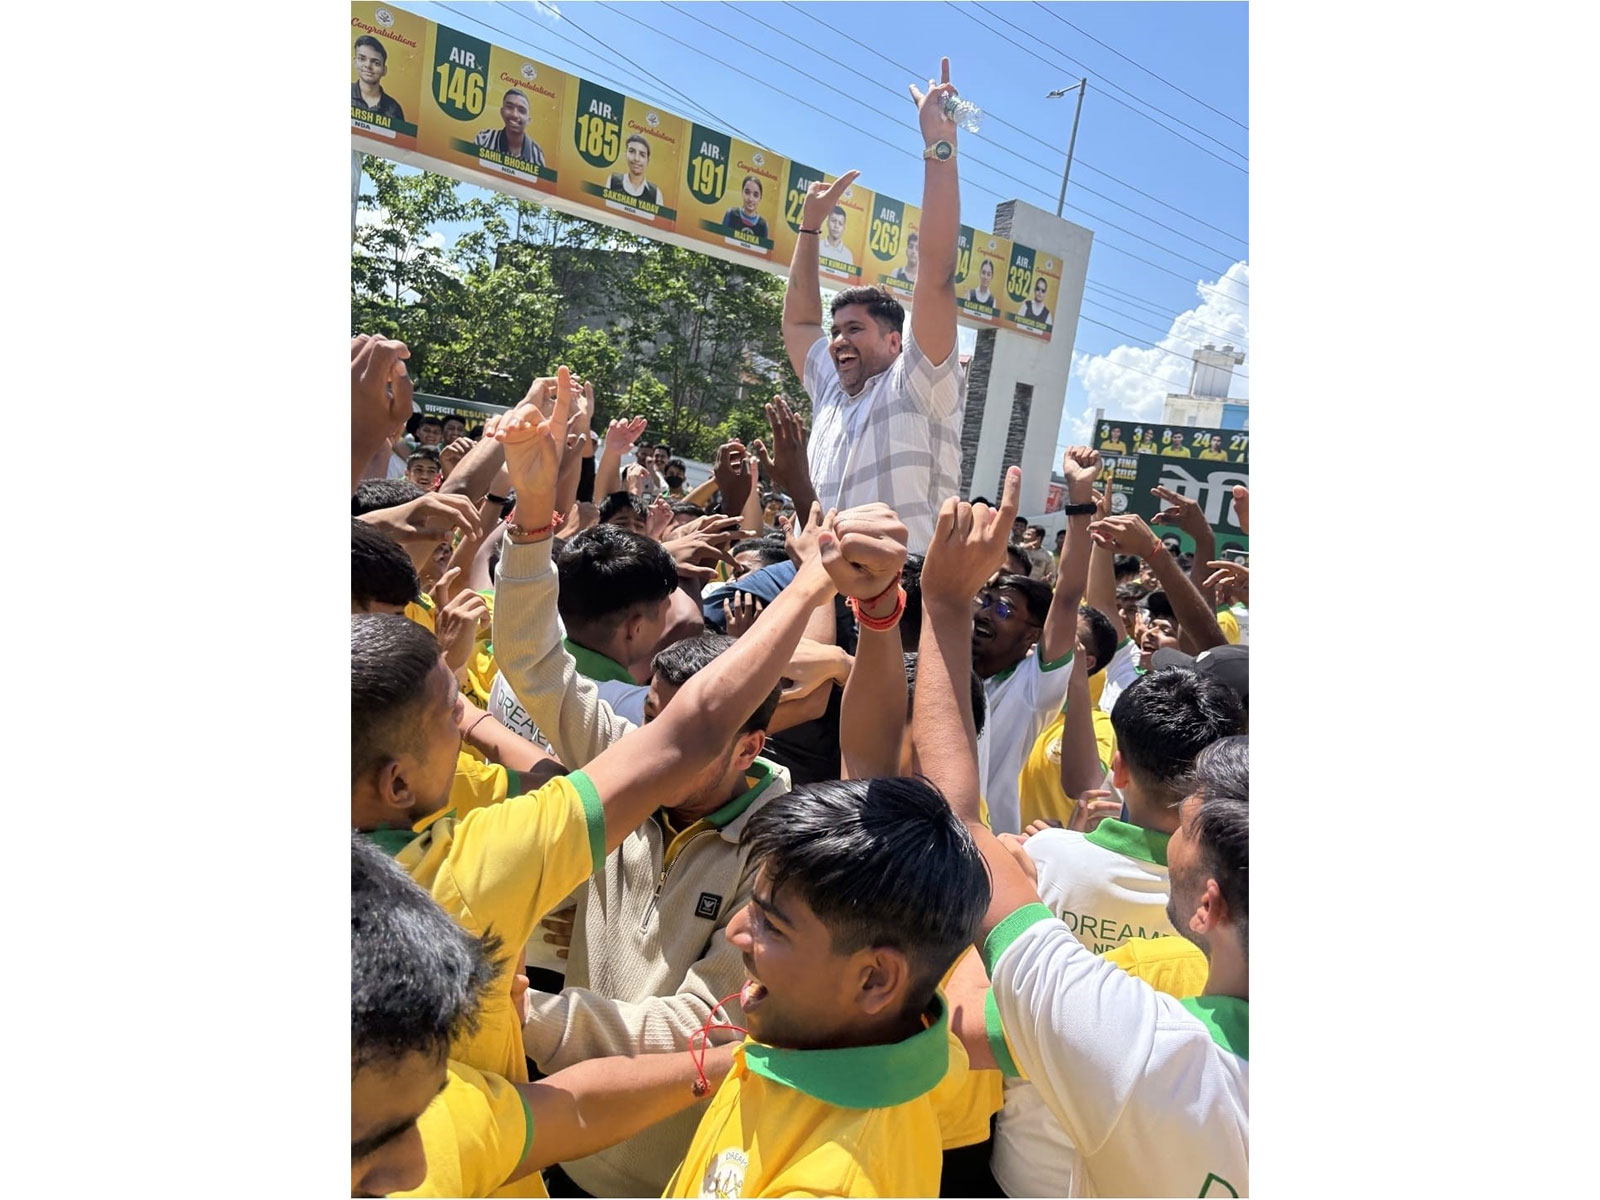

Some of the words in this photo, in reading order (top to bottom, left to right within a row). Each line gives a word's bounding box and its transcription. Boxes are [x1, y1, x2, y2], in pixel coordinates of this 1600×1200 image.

[351, 17, 417, 49] Congratulations
[449, 46, 475, 68] AIR
[437, 63, 485, 115] 146
[500, 72, 556, 99] Congratulations
[351, 107, 374, 122] ARSH
[375, 114, 391, 128] RAI
[589, 99, 612, 119] AIR
[354, 120, 371, 130] NDA
[578, 114, 619, 162] 185
[700, 141, 720, 160] AIR
[479, 148, 502, 164] SAHIL
[504, 157, 540, 175] BHOSALE
[692, 156, 724, 198] 191
[797, 177, 813, 190] AI
[880, 207, 896, 223] AIR
[870, 219, 900, 257] 263
[1016, 255, 1030, 269] AIR
[1008, 266, 1032, 298] 332
[1100, 425, 1110, 439] 3
[1133, 428, 1143, 442] 3
[1162, 430, 1172, 444] 8
[1192, 432, 1211, 448] 24
[1229, 434, 1249, 451] 27
[1117, 458, 1137, 470] FINA
[1116, 468, 1137, 480] SELEC
